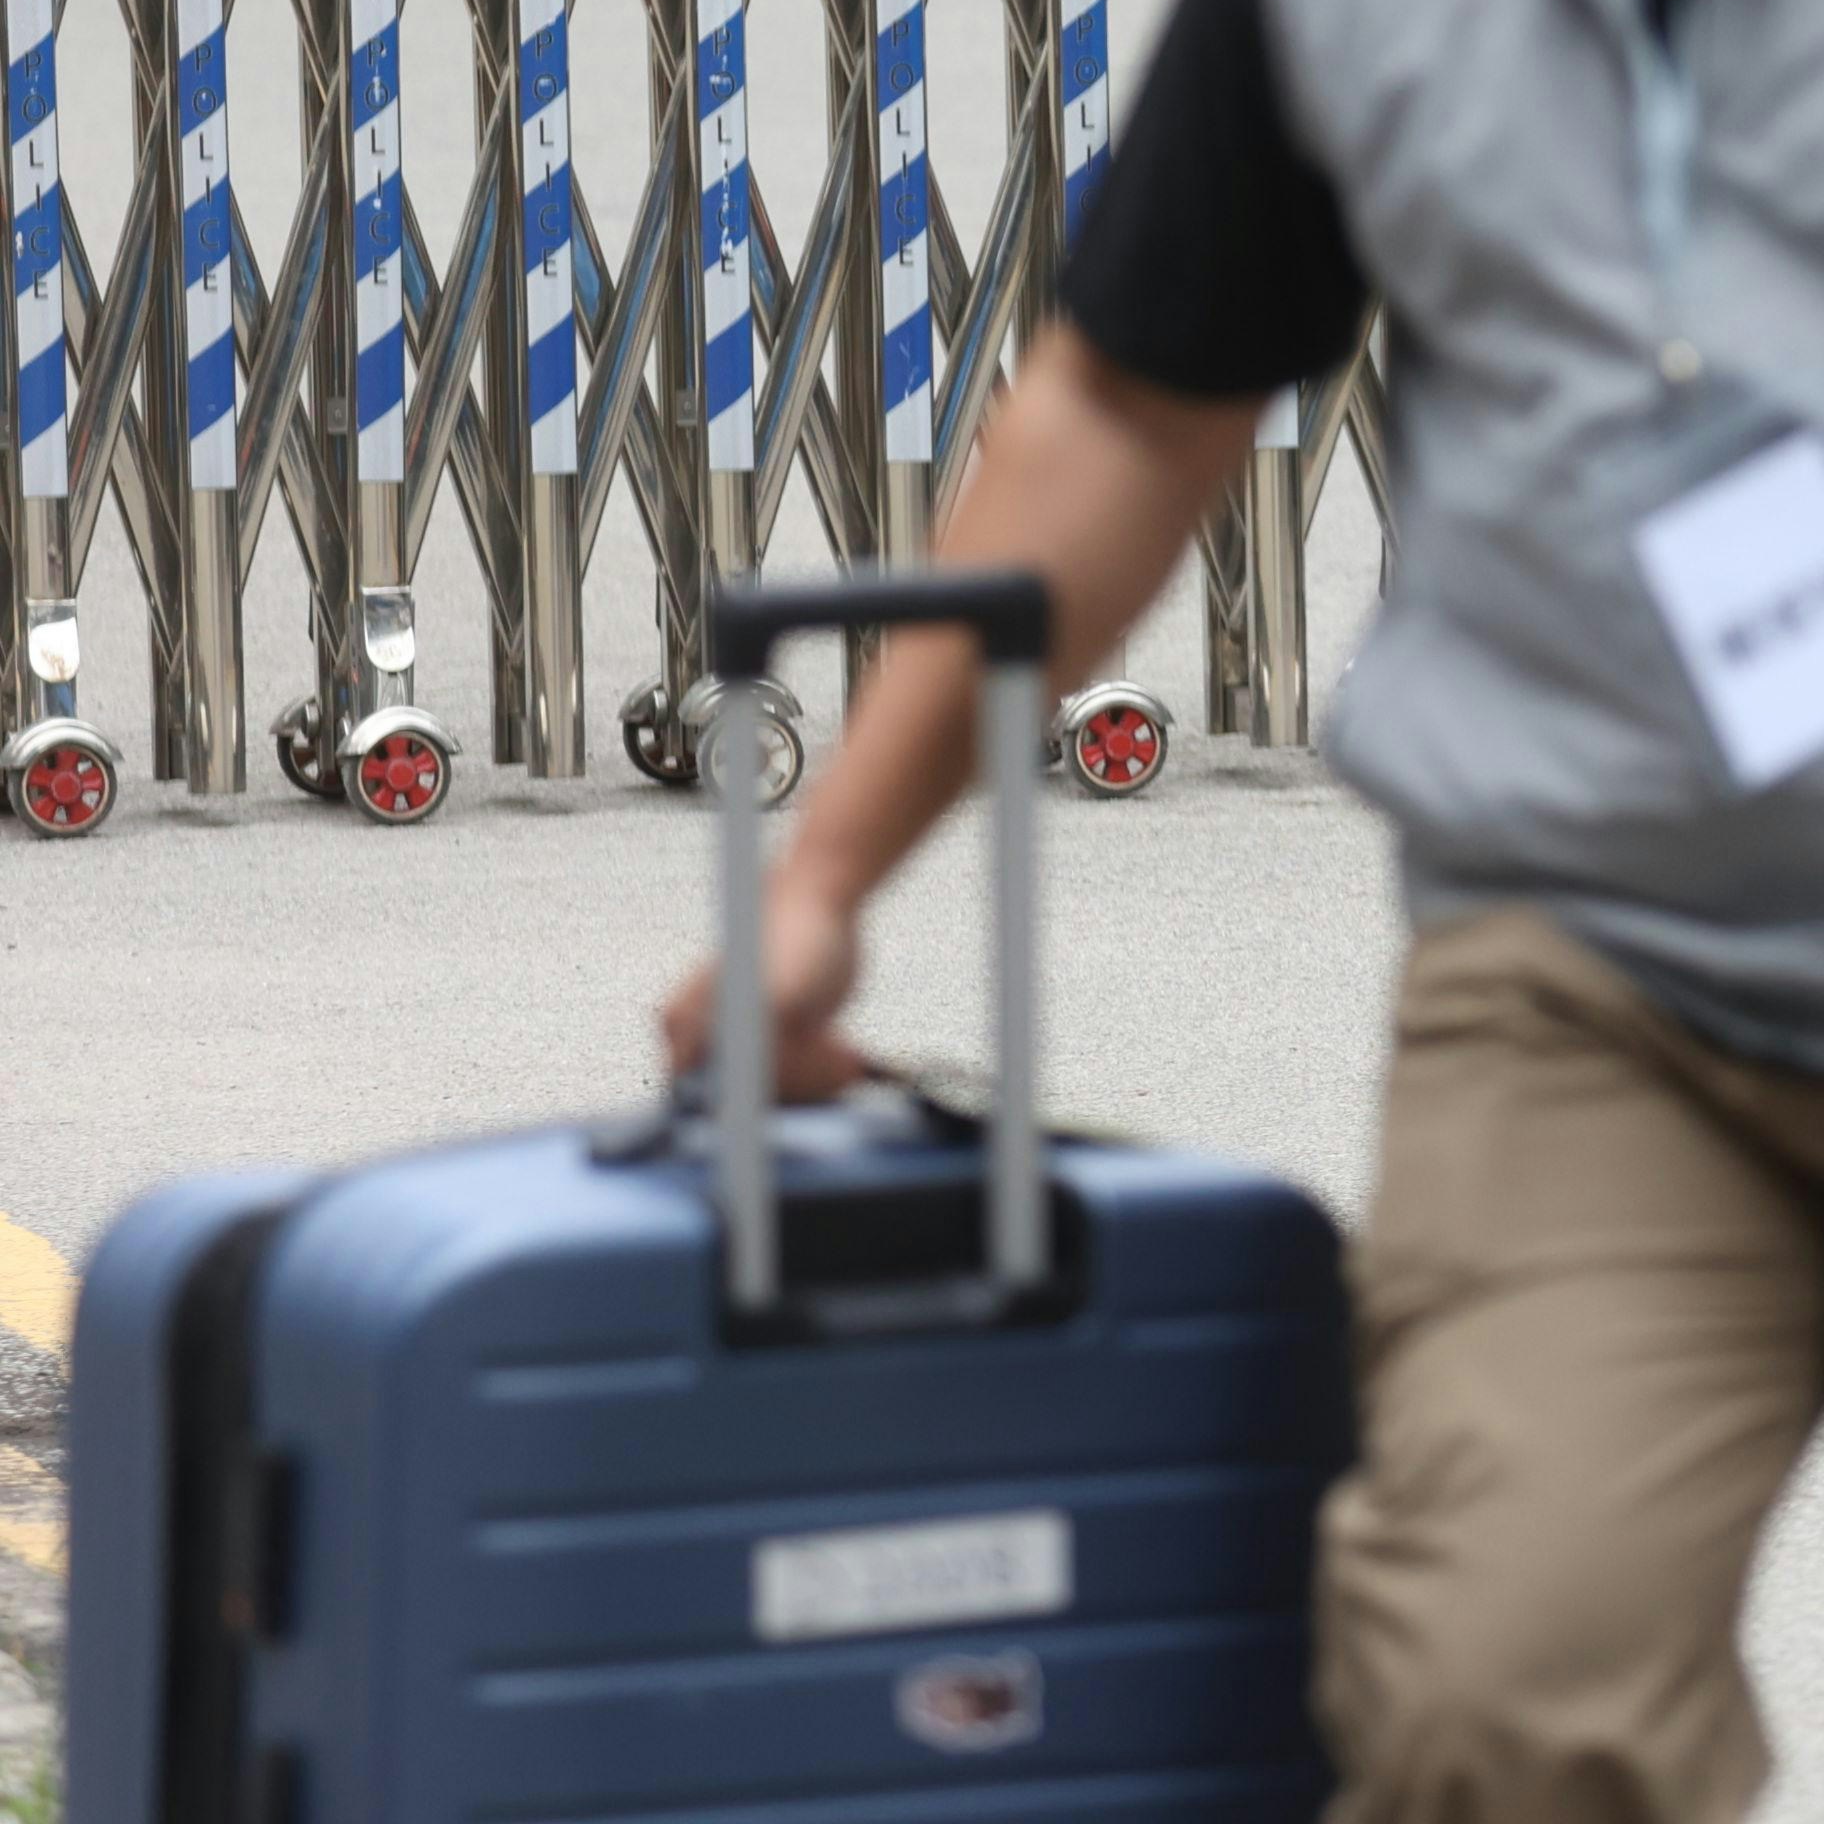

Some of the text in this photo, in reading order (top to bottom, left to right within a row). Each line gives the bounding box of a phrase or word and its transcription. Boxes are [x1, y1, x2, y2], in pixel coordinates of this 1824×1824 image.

[23, 52, 49, 300] POLICE
[193, 43, 219, 292] POLICE
[364, 38, 389, 286] POLICE
[533, 30, 558, 278] POLICE
[890, 20, 916, 266] POLICE
